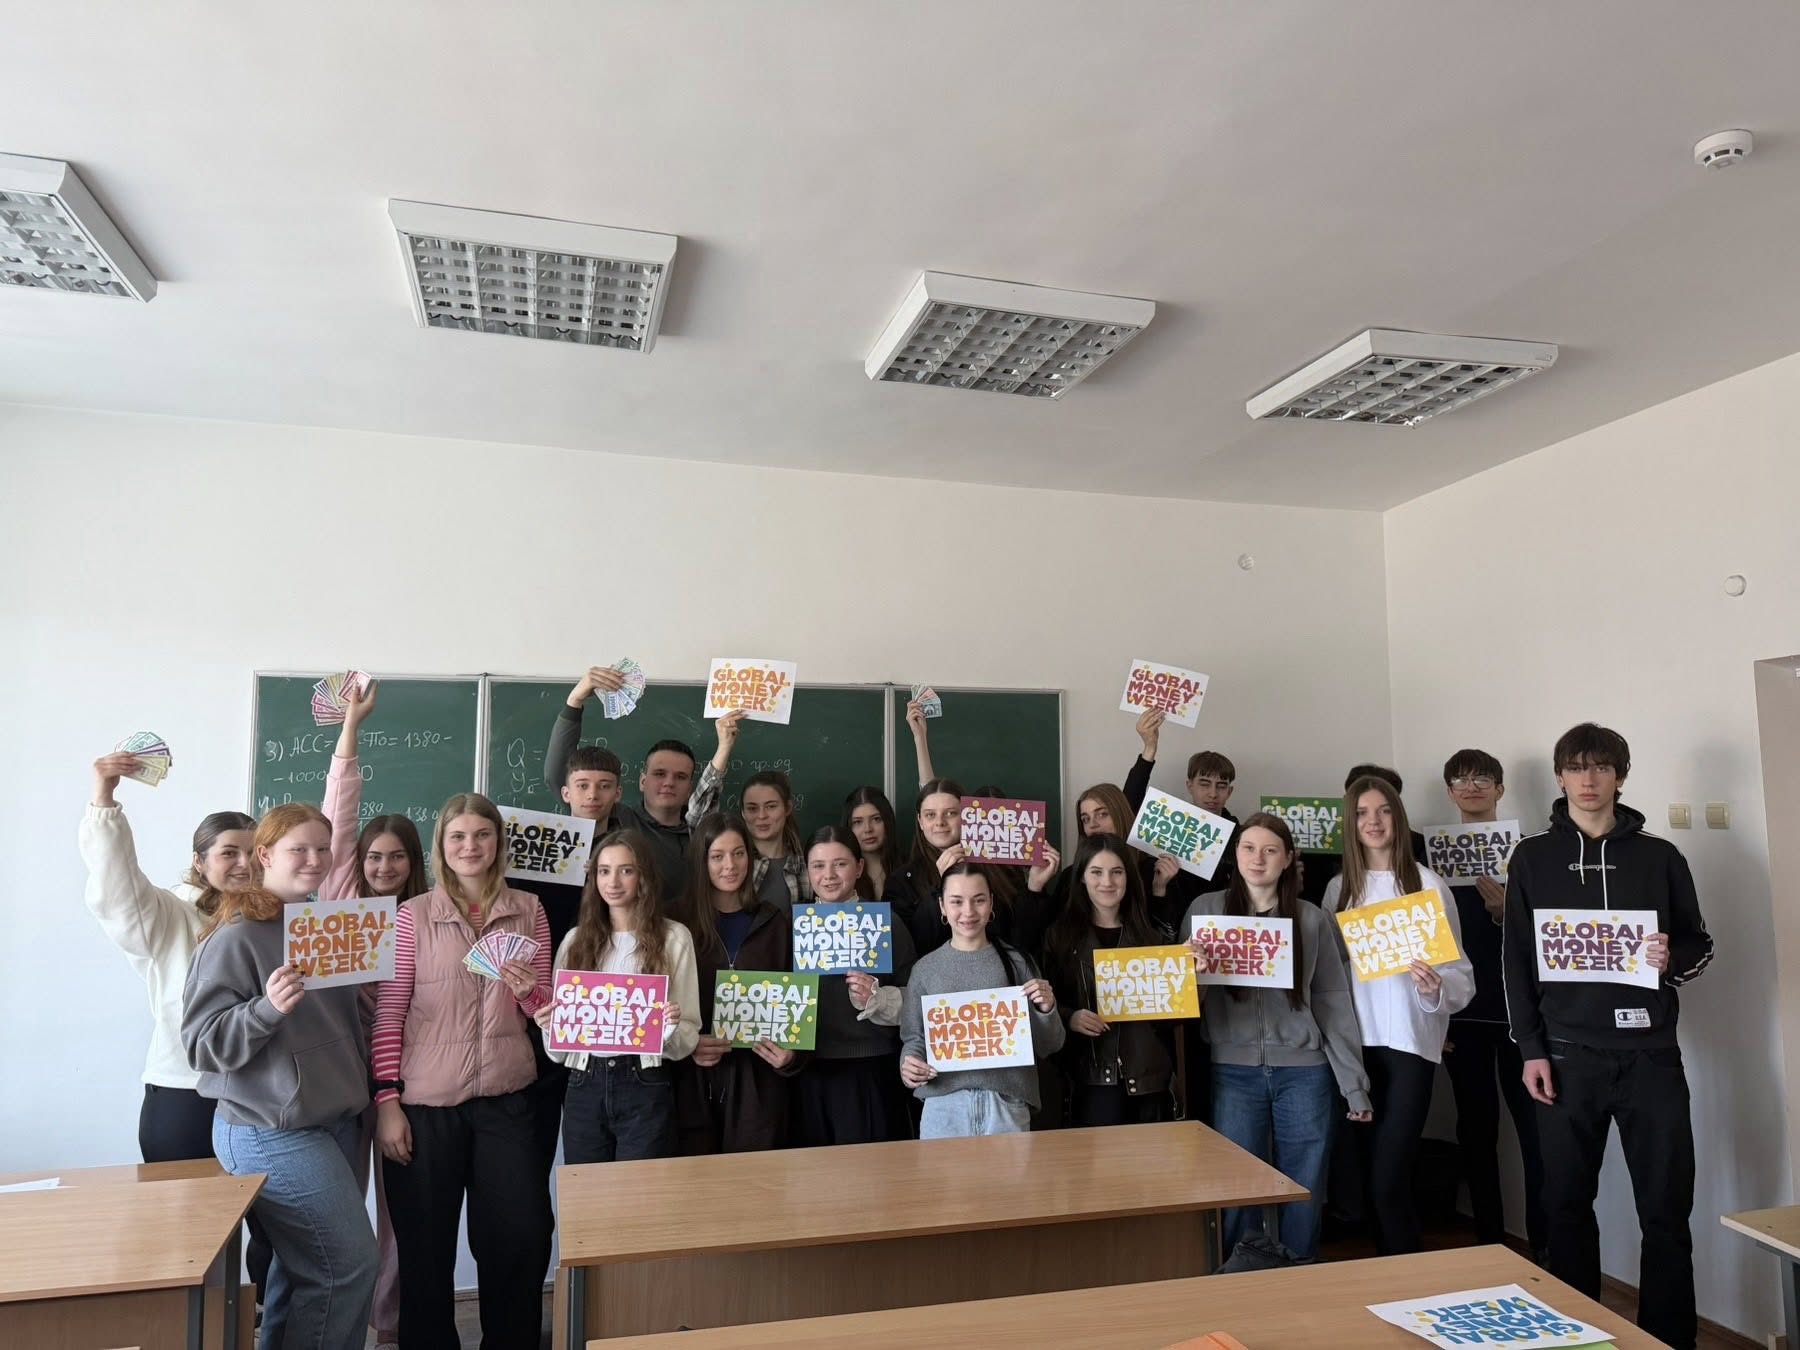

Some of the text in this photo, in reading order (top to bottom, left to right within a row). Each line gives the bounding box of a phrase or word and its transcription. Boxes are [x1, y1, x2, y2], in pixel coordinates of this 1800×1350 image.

[714, 669, 790, 685] GLOBAL
[1132, 669, 1203, 695] GLOBAL
[711, 682, 781, 697] MONEY
[1128, 681, 1194, 704] MONEY
[710, 695, 766, 711] WEEK
[1127, 692, 1179, 714] WEEK
[961, 807, 1044, 828] GLOBAL
[1147, 800, 1222, 844] GLOBAL
[961, 824, 1037, 842] MONEY
[1138, 824, 1195, 861] WEEK
[1140, 813, 1213, 850] MONEY
[1429, 831, 1519, 849] GLOBAL
[507, 838, 576, 859] ONEY
[961, 840, 1024, 859] WEEK
[1431, 846, 1510, 864] MONEY
[1432, 862, 1500, 877] WEEK
[289, 911, 394, 938] GLOBAL
[794, 914, 890, 933] GLOBAL
[1344, 901, 1444, 939] GLOBAL
[289, 930, 384, 958] MONEY
[794, 932, 881, 950] MONEY
[1197, 928, 1288, 946] GLOBAL
[1350, 920, 1436, 958] MONEY
[1542, 939, 1642, 956] MONEY
[794, 950, 867, 970] WEEK
[1096, 957, 1194, 978] GLOBAL
[1352, 942, 1431, 974] WEEK
[1543, 955, 1626, 972] WEEK
[716, 982, 816, 1004] GLOBAL
[1098, 974, 1185, 996] MONEY
[557, 984, 664, 1009] GLOBAL
[1098, 994, 1173, 1016] WEEK
[554, 1004, 652, 1026] MONEY
[715, 1002, 807, 1022] MONEY
[928, 1000, 1026, 1024] GLOBAL
[553, 1024, 634, 1045] WEEK
[713, 1020, 789, 1042] WEEK
[929, 1018, 1017, 1042] MONEY
[930, 1038, 1006, 1061] WEEK
[1424, 1296, 1543, 1322] WEEK
[1431, 1310, 1563, 1333] MONEY
[1427, 1323, 1583, 1344] GLOBAL
